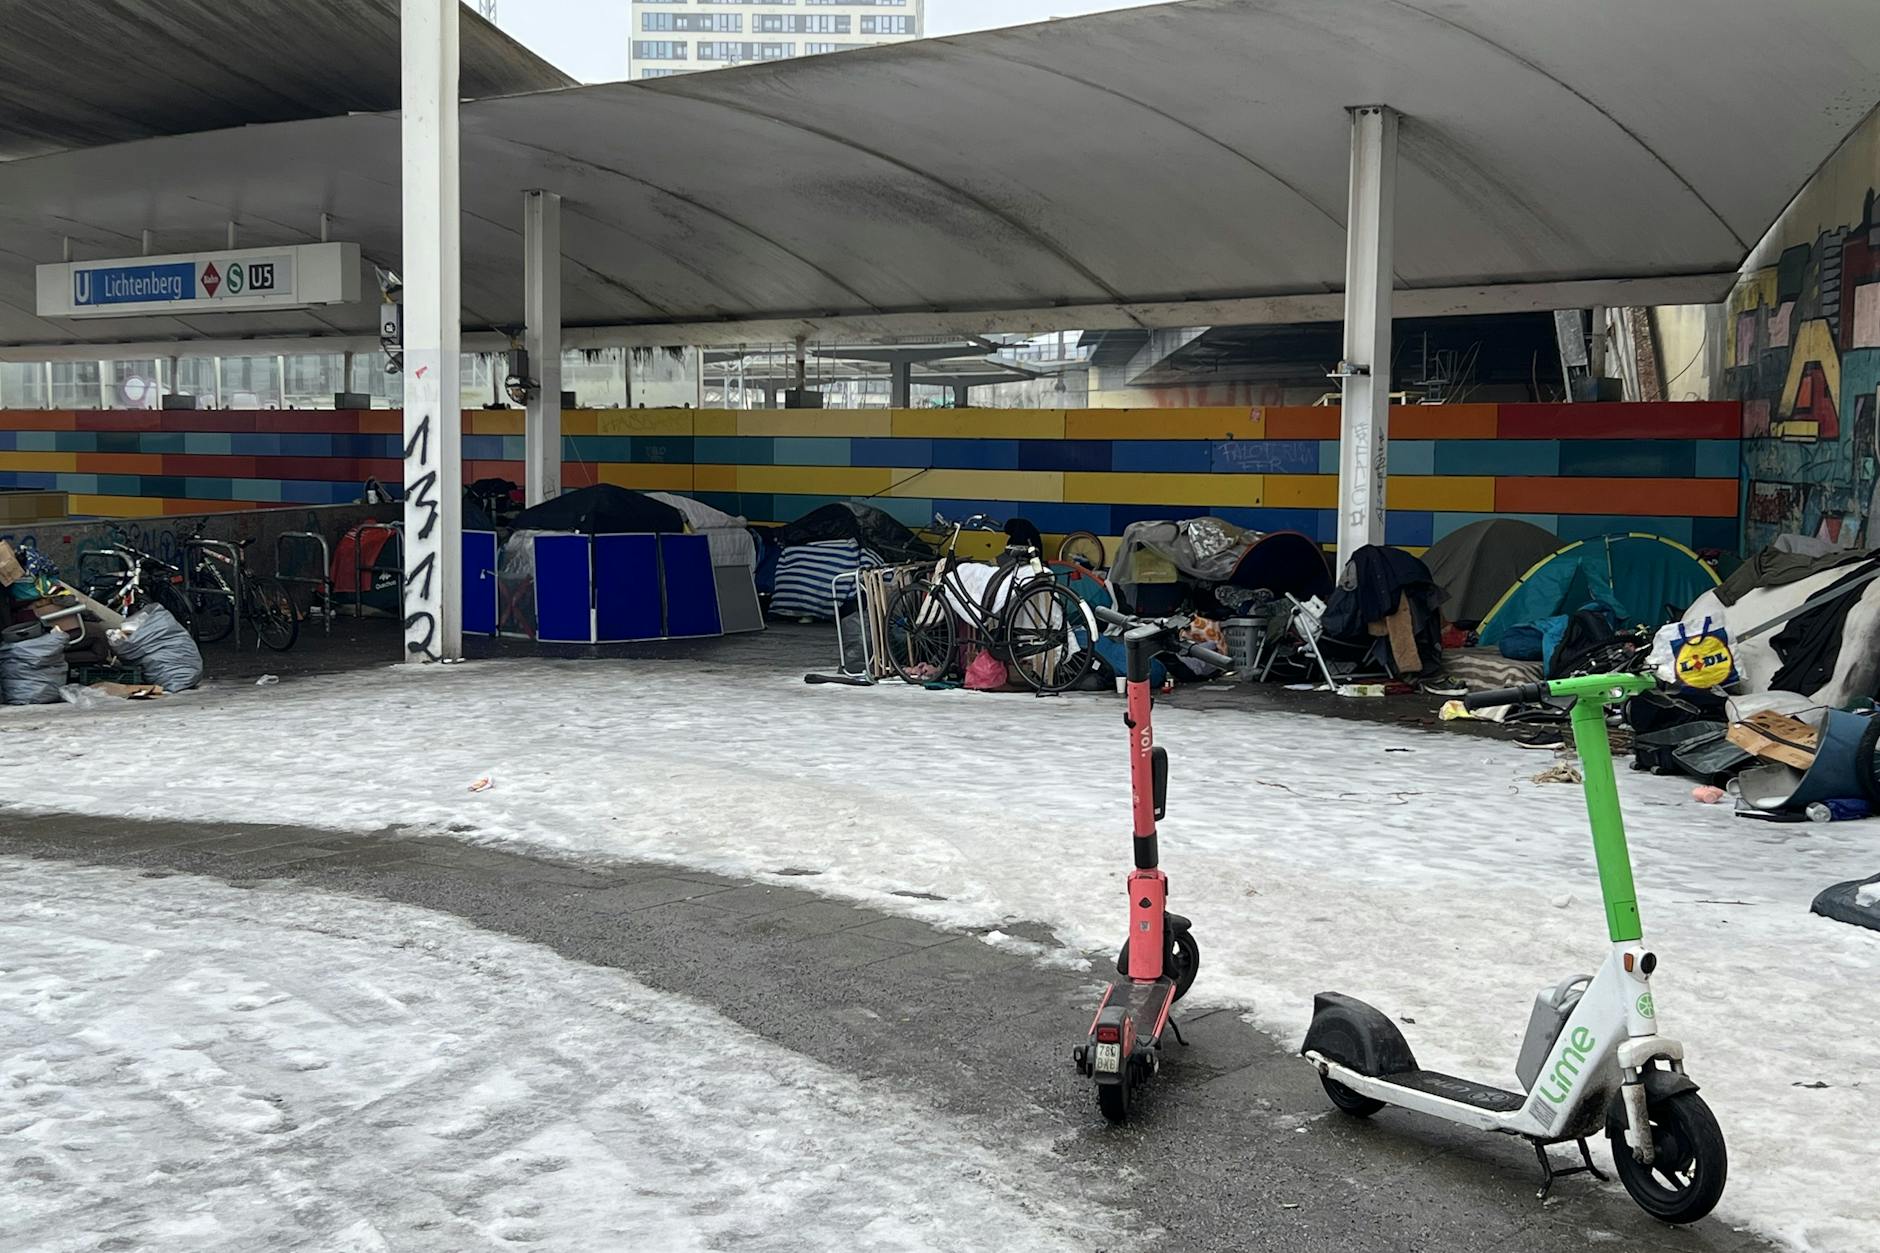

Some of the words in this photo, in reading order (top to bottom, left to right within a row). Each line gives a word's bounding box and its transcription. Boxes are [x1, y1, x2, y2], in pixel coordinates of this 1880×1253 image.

[76, 272, 90, 302] U
[104, 273, 182, 300] Lichtenberg
[229, 266, 242, 291] S
[251, 266, 272, 287] U5
[1679, 652, 1728, 673] LIDL
[1539, 1026, 1596, 1103] Lime
